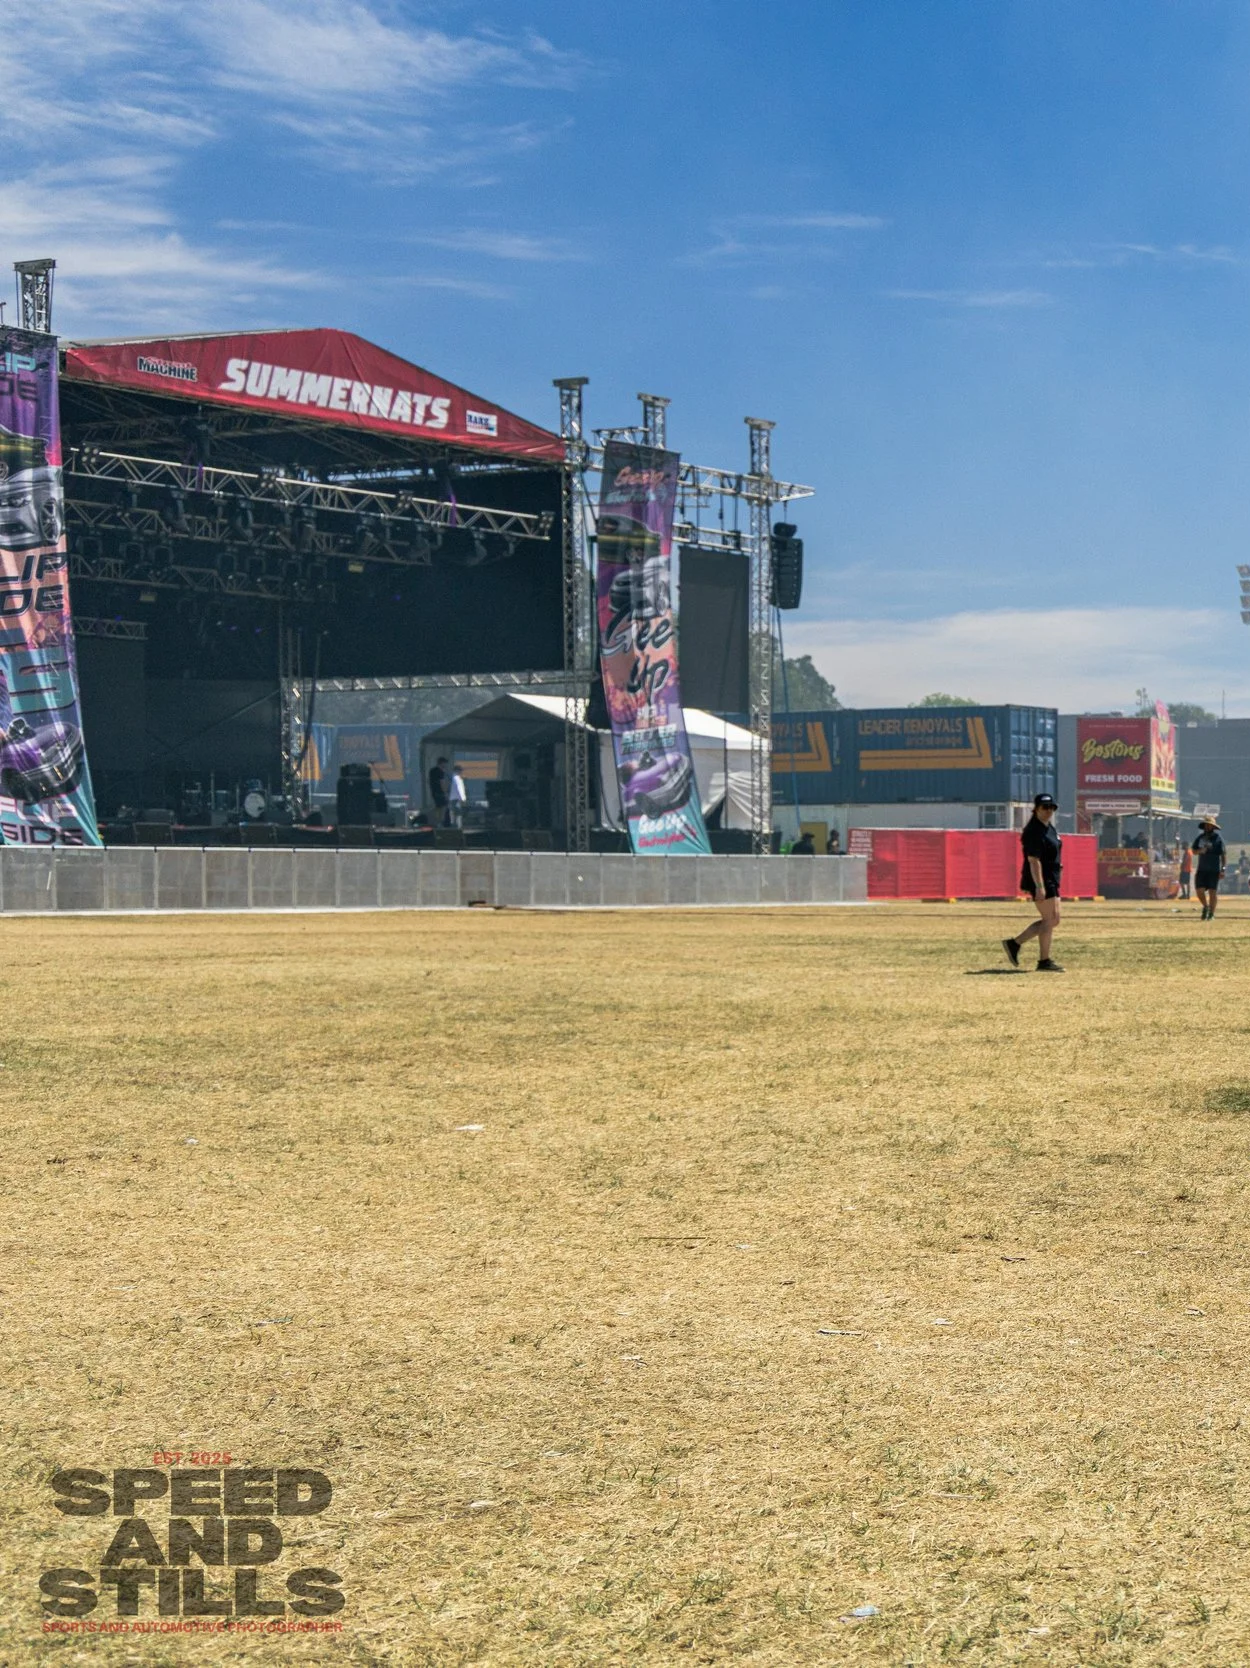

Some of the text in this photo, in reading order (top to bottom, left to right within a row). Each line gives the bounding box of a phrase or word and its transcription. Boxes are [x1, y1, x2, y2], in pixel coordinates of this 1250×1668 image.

[137, 357, 197, 382] MACHINE
[218, 358, 452, 430] SUMMERNATS
[1085, 774, 1114, 783] FRESH
[1117, 774, 1143, 783] FOOD
